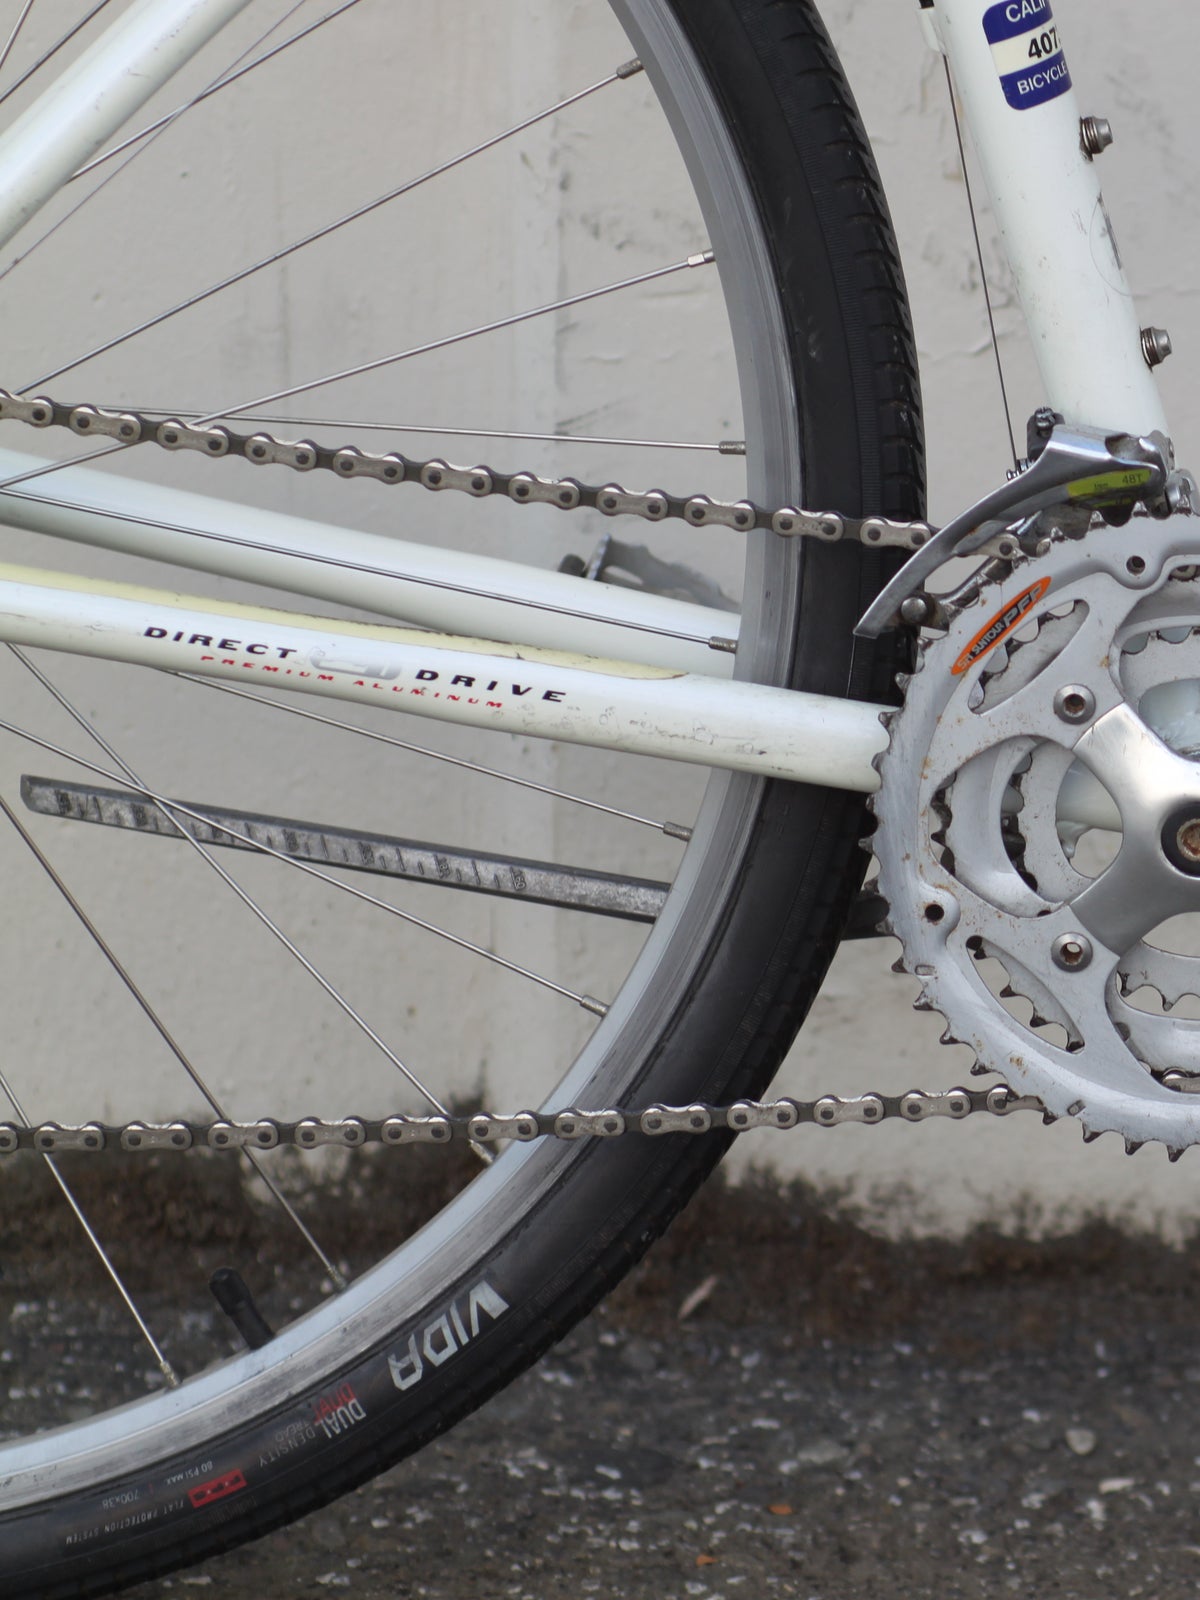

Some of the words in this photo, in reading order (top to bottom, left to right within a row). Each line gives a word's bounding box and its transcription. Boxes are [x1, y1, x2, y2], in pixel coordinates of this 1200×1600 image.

[1017, 60, 1068, 95] BICYCLE
[972, 621, 1005, 655] SUNTOUR
[143, 626, 298, 659] DIRECT
[415, 669, 566, 702] DRIVE
[201, 655, 335, 682] PREMIUM
[353, 679, 503, 708] ALUMINUM
[387, 1280, 510, 1391] VIDA
[275, 1418, 311, 1443] TREAD
[314, 1397, 367, 1439] DUAL
[258, 1426, 316, 1468] DENSITY
[104, 1509, 159, 1534] PROTECTION
[162, 1500, 184, 1516] FLAT
[65, 1532, 99, 1545] SYSTEM
